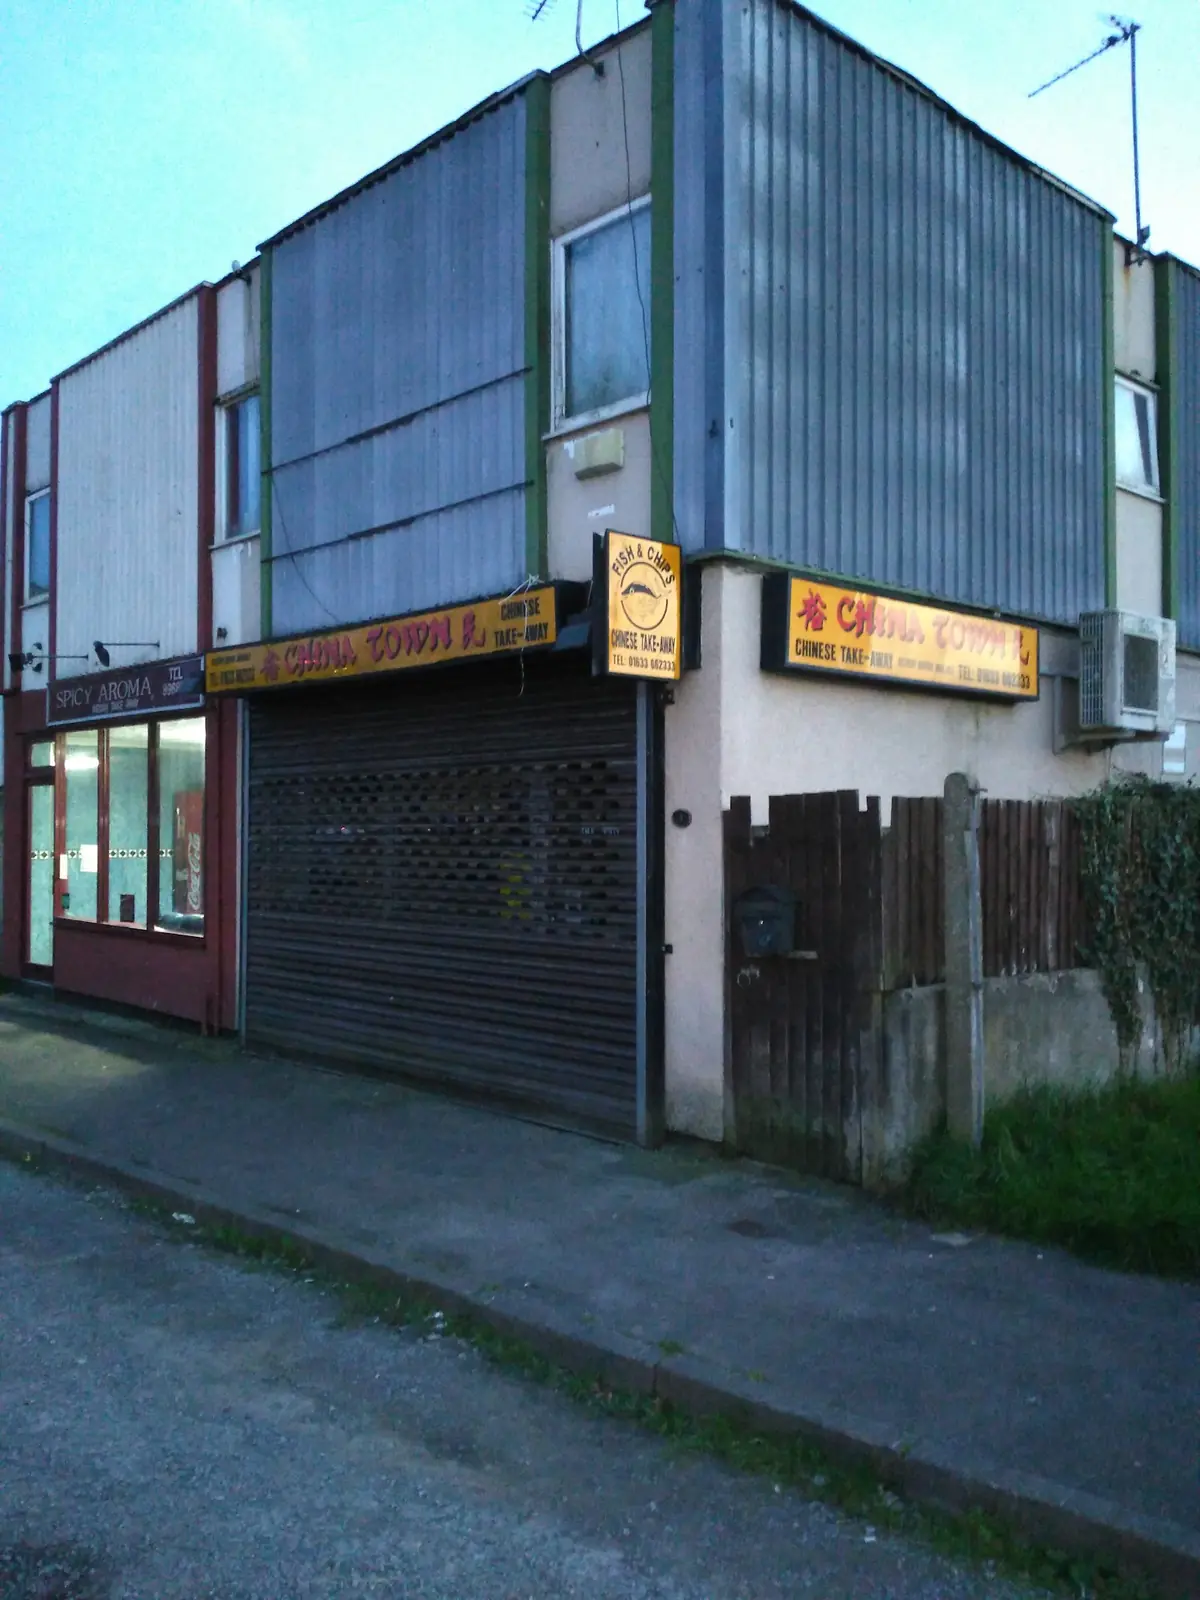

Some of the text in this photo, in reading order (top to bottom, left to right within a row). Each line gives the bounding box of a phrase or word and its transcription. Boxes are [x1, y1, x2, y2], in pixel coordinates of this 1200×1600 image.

[612, 543, 675, 585] FISH & CHIPS
[501, 596, 541, 621] CHINESE
[837, 596, 925, 645] CHINA
[284, 635, 357, 677] CHINA
[366, 616, 453, 662] TOWN
[494, 622, 549, 648] TAKE-AWAY
[611, 628, 676, 655] CHINESE TAKE-AWAY
[613, 654, 627, 666] TEL:
[629, 656, 648, 669] 01633
[795, 638, 836, 661] CHINESE
[841, 645, 893, 669] TAKE-AWAY
[56, 685, 93, 709] SPICY
[98, 676, 152, 702] AROMA
